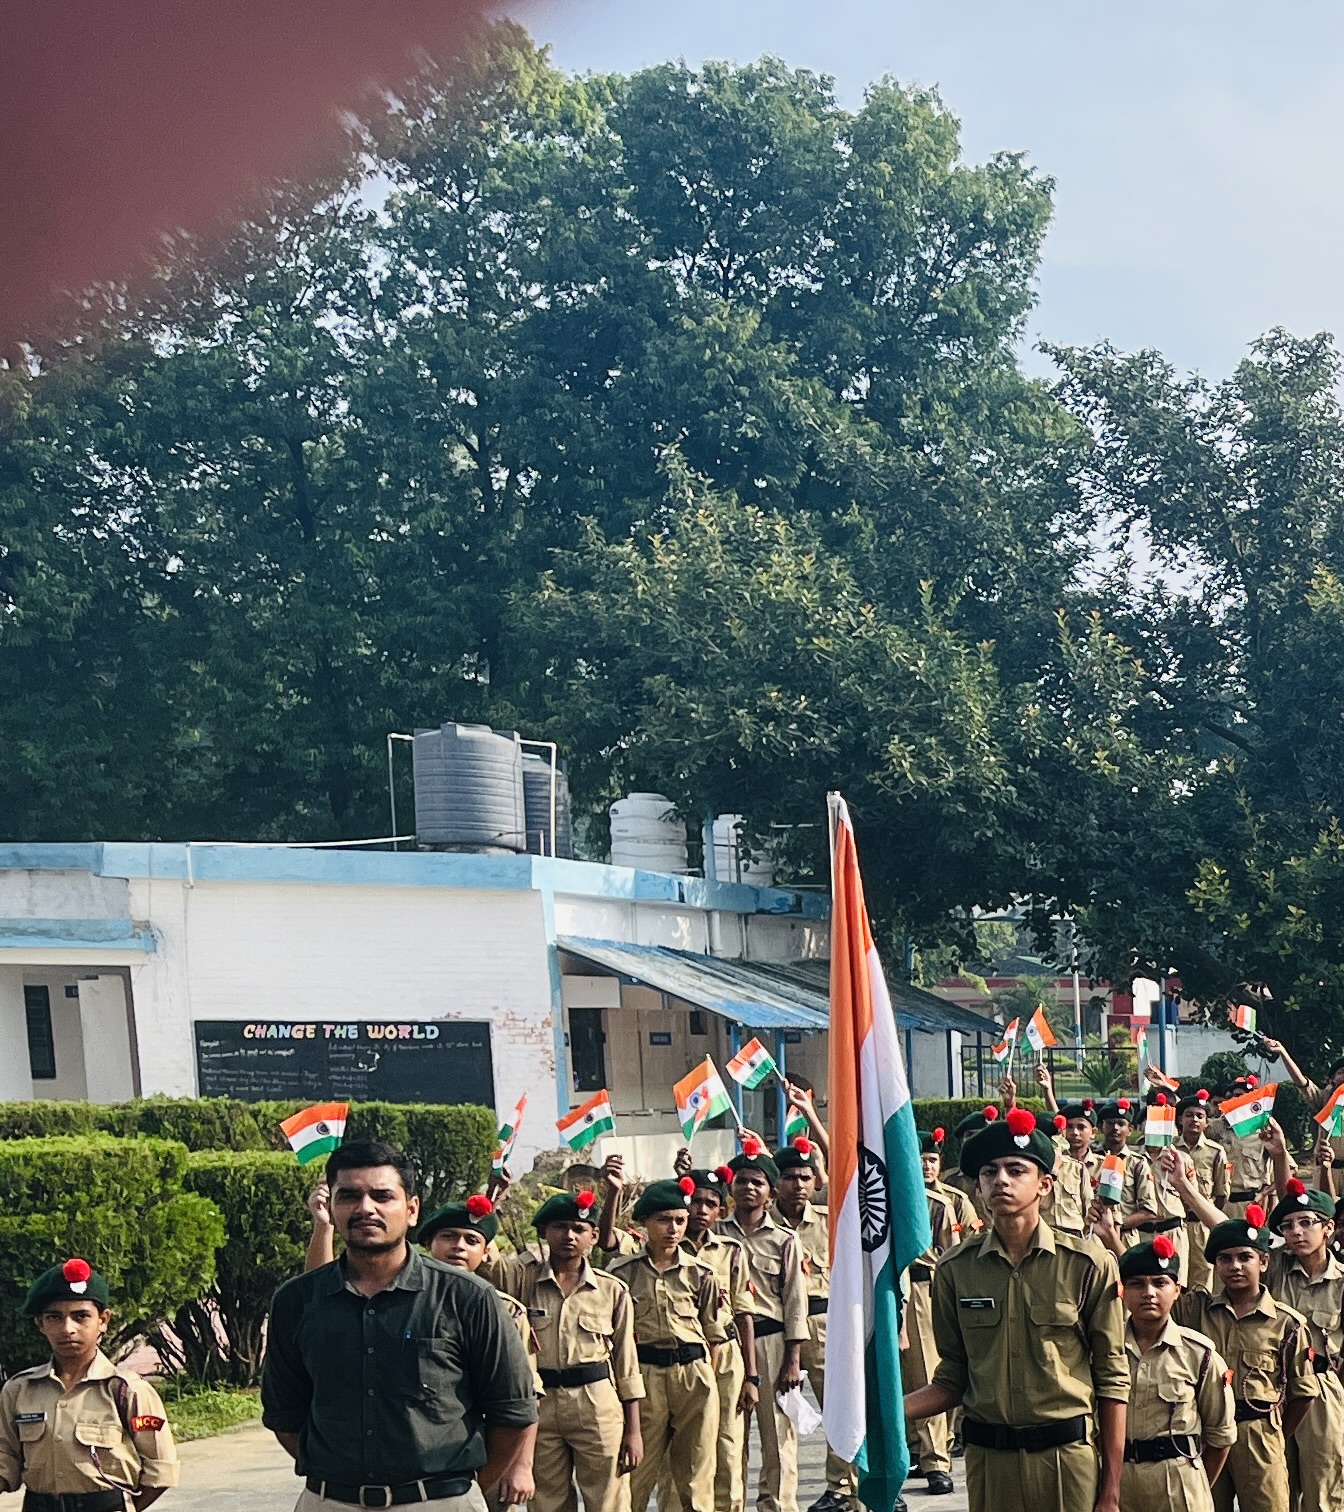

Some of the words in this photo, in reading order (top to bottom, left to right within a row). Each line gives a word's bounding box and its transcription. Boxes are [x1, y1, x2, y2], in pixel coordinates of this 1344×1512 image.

[243, 1024, 316, 1040] CHANGE
[322, 1024, 358, 1040] THE
[366, 1024, 440, 1040] WORLD
[135, 1417, 160, 1429] NCC
